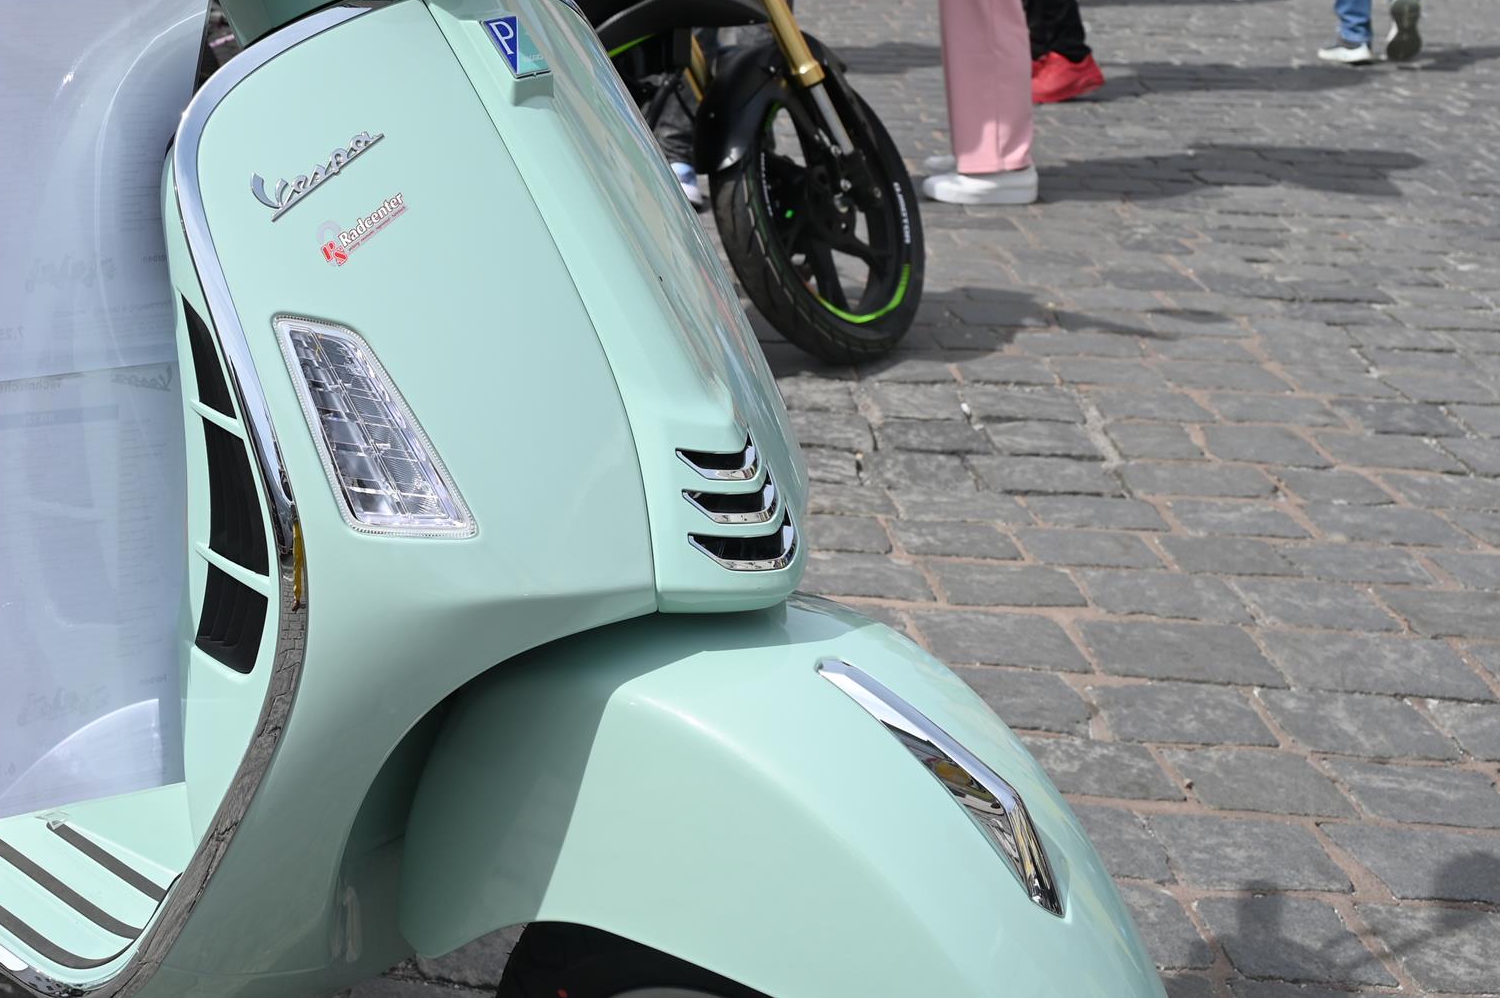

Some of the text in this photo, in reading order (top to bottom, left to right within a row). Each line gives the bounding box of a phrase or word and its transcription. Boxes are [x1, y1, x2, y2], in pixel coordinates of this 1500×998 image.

[488, 21, 515, 55] P
[250, 130, 385, 223] Vespa
[338, 192, 404, 248] Radcenter
